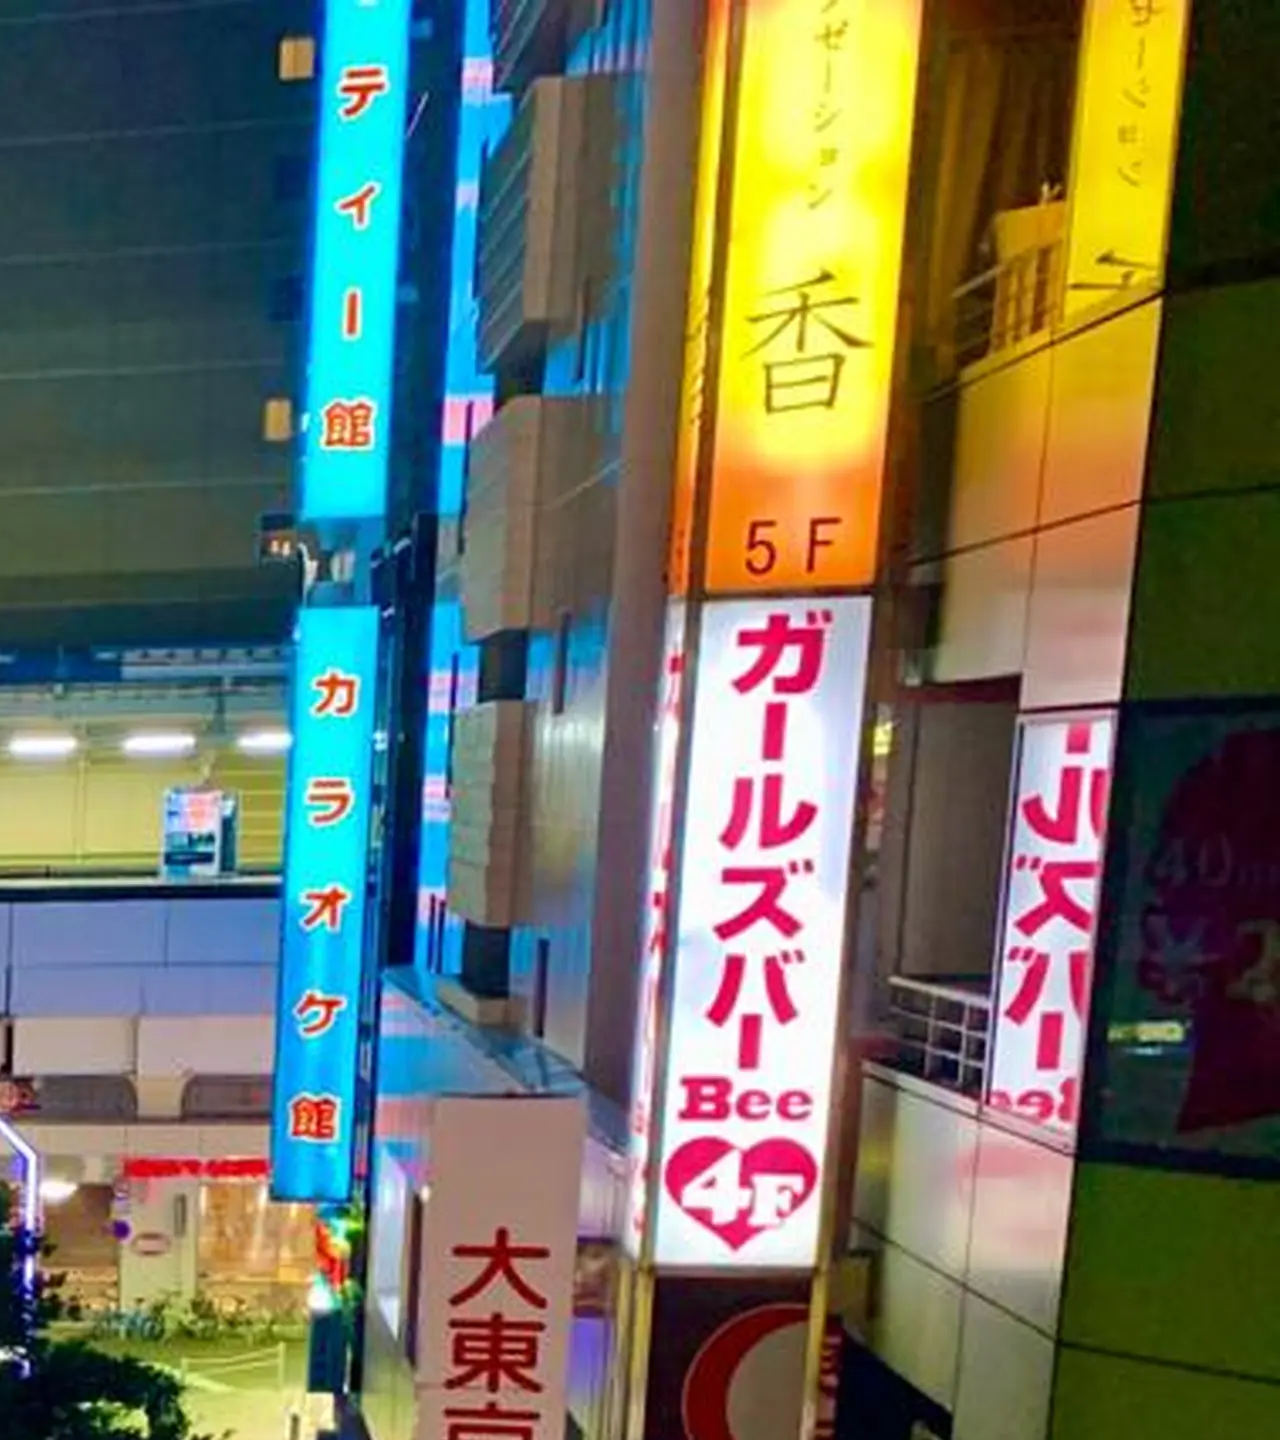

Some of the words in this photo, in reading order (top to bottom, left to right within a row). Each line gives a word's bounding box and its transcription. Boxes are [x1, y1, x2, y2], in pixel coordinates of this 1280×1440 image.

[807, 0, 849, 210] ゼーション
[740, 268, 876, 416] 香
[743, 516, 842, 576] 5F
[289, 670, 359, 1143] カラオケ館
[706, 608, 833, 1070] ガールズバー
[678, 1076, 812, 1122] Bee
[681, 1148, 804, 1230] 4F
